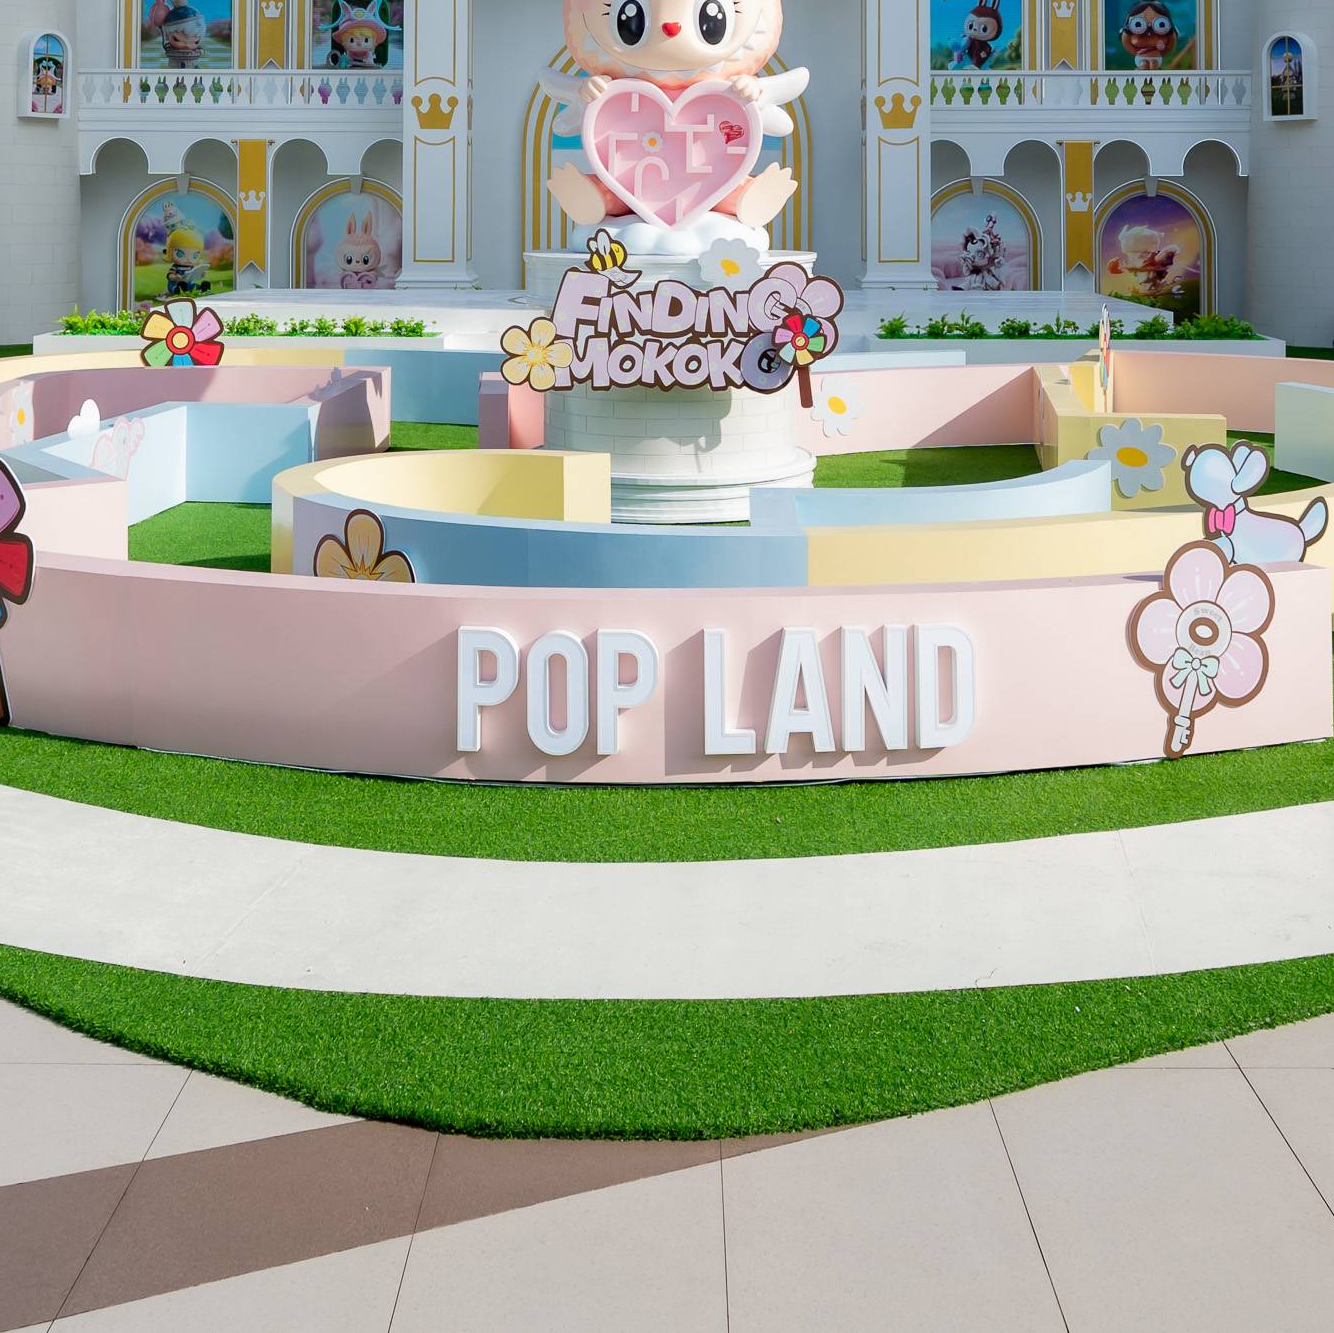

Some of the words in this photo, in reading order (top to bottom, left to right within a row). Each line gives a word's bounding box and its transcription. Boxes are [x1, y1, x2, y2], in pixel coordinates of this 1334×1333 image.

[553, 326, 797, 393] MOKOKO
[457, 625, 659, 756] POP
[702, 623, 976, 755] LAND
